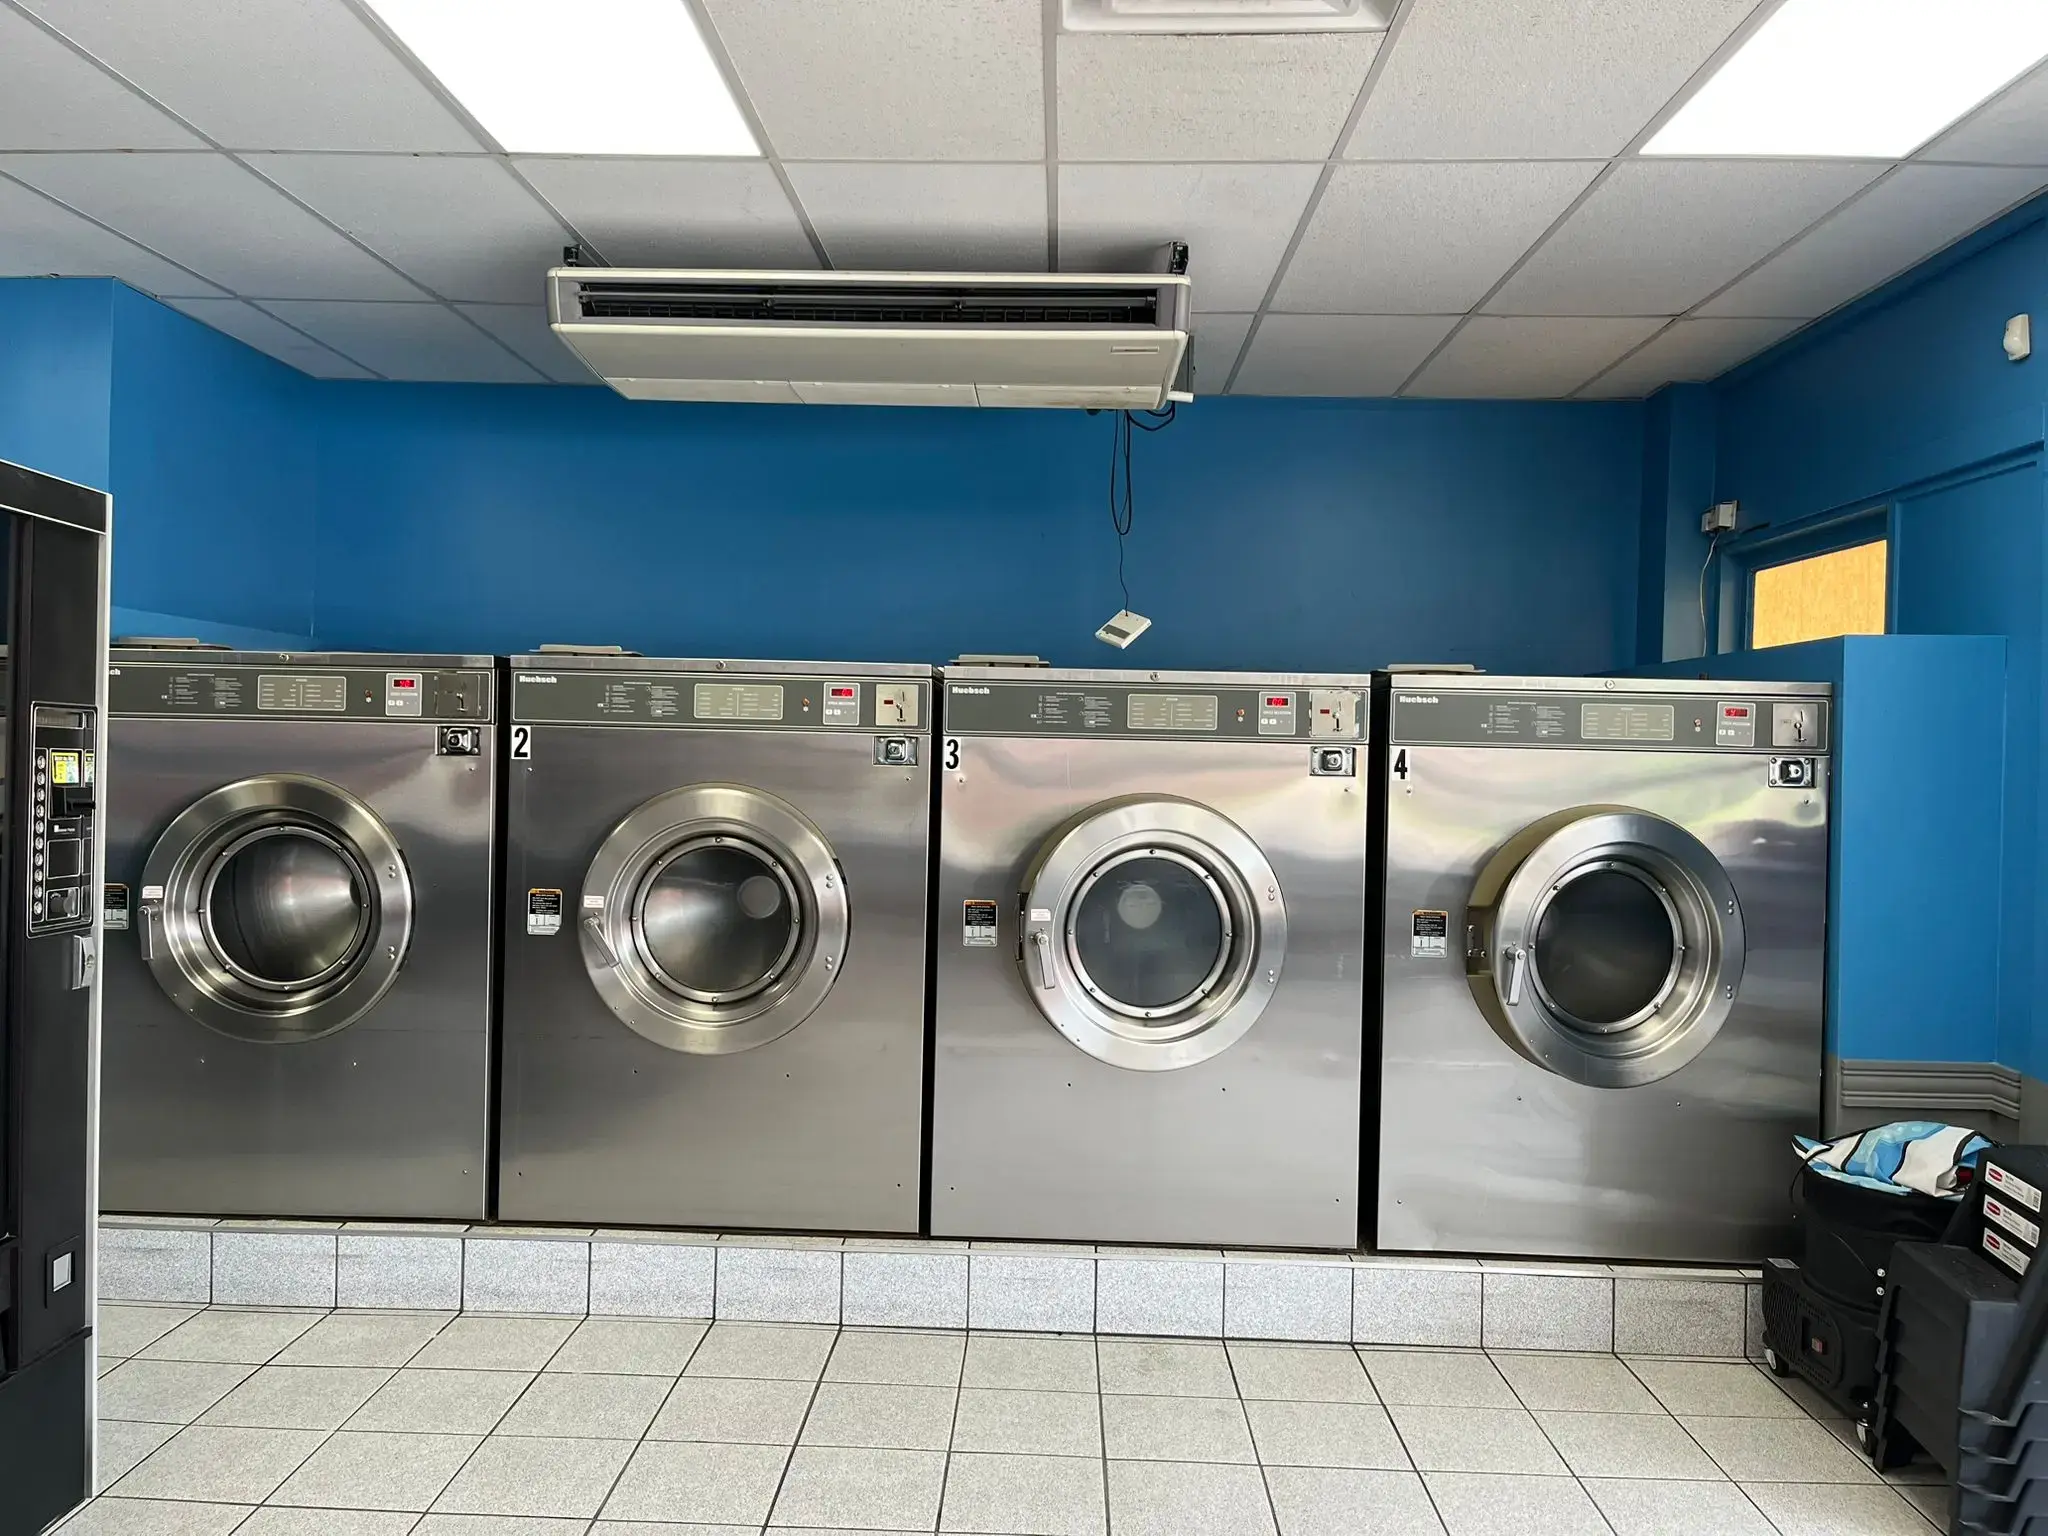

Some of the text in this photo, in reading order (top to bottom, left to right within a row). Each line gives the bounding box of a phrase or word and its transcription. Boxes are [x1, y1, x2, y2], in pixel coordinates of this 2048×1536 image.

[519, 675, 558, 684] Huebsch
[952, 686, 990, 695] Huebsch
[1399, 695, 1439, 704] Huebsch
[513, 727, 529, 758] 2
[945, 738, 959, 770] 3
[1393, 748, 1408, 780] 4
